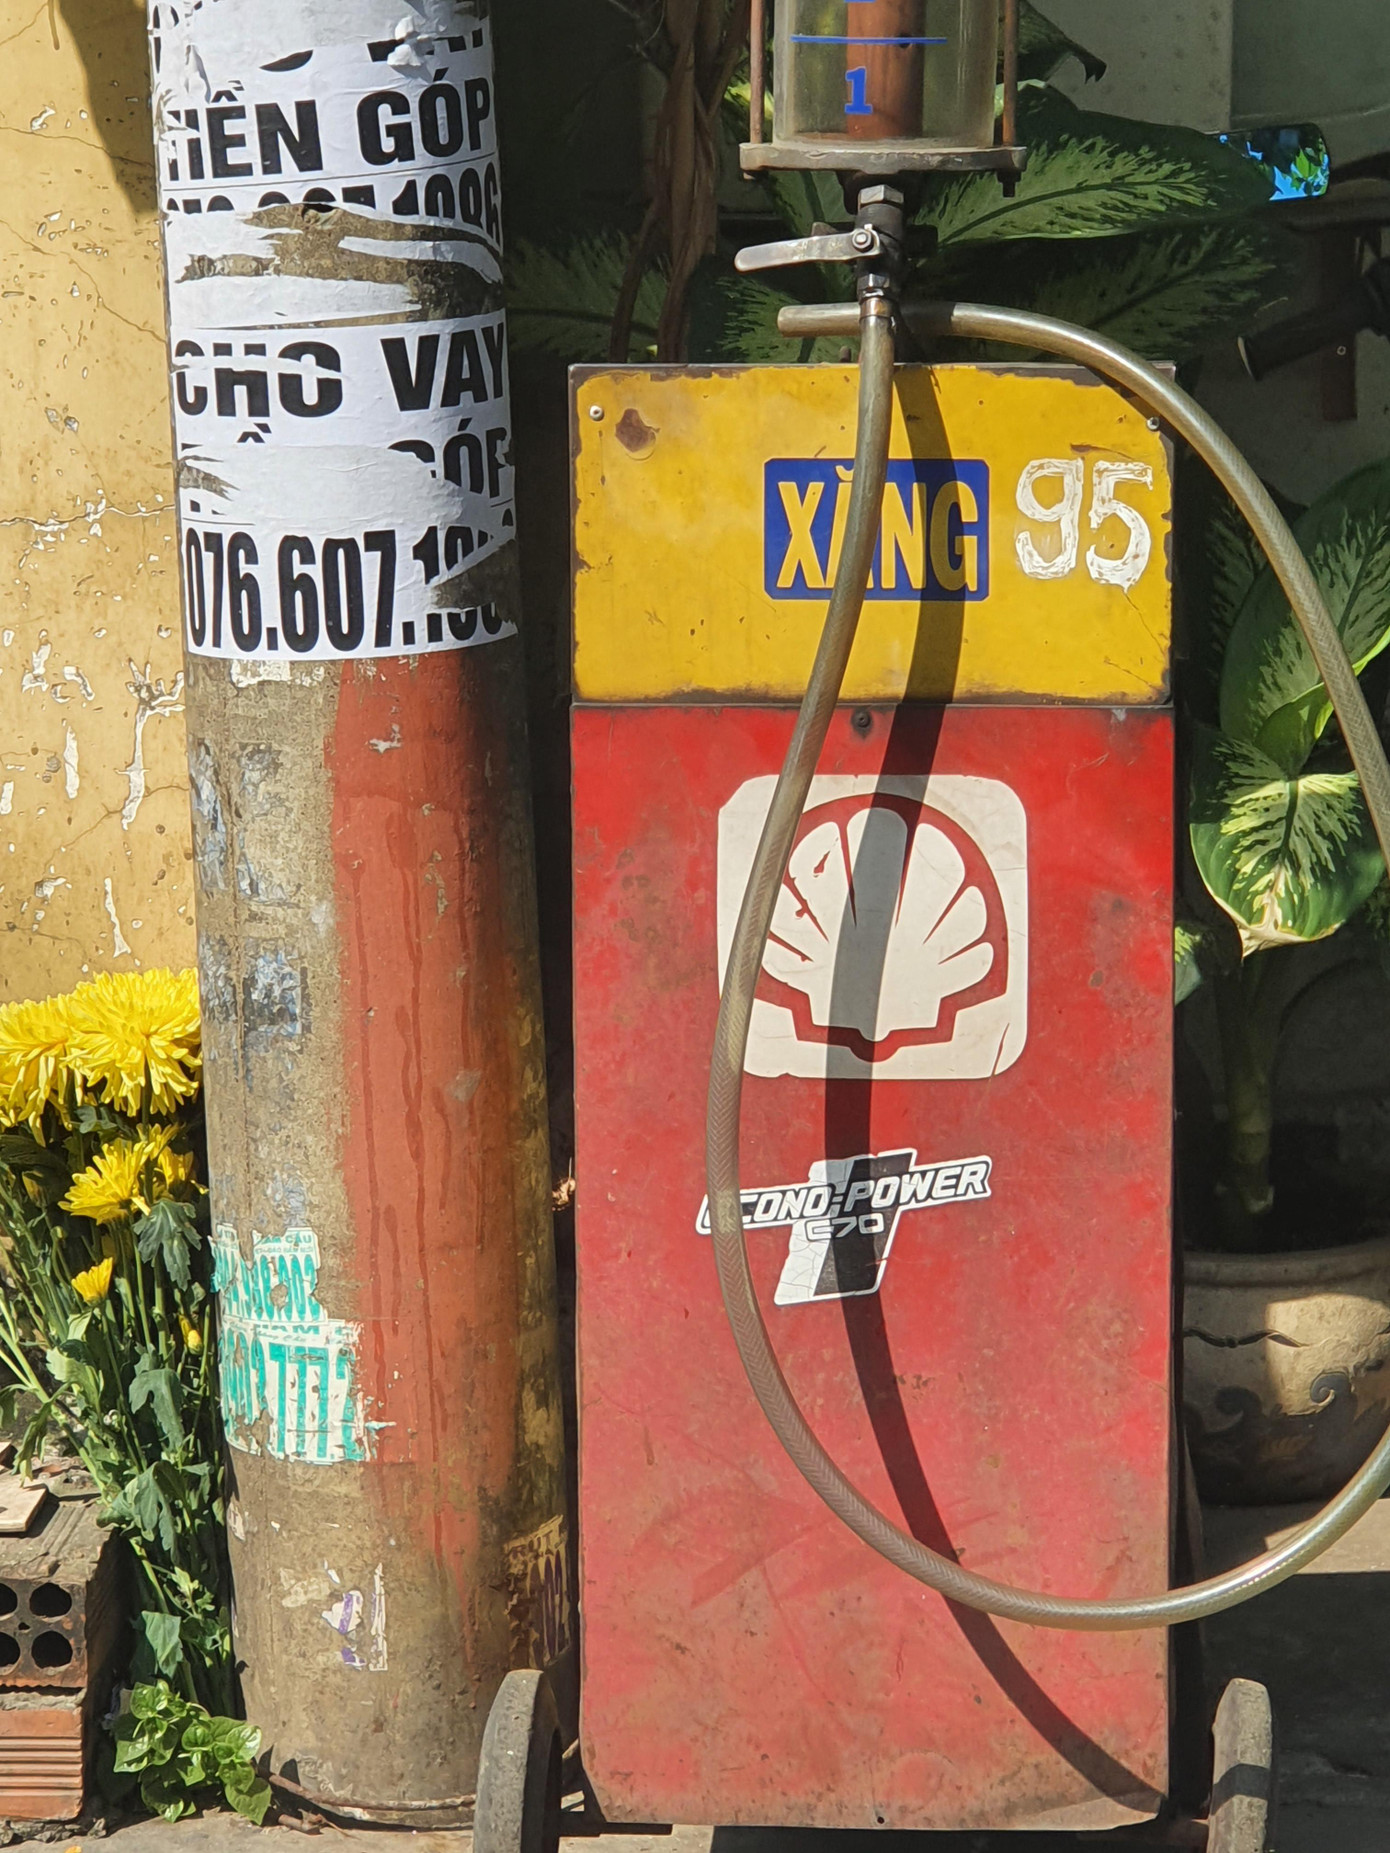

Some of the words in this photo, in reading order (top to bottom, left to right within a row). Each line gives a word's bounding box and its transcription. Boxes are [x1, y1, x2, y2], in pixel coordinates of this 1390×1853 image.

[356, 67, 491, 166] GÓP
[845, 66, 873, 115] 1
[175, 339, 344, 418] CHO
[380, 321, 504, 412] VAY
[387, 417, 508, 499] ÓP
[1014, 456, 1153, 594] 95
[703, 1163, 987, 1227] CONO-POWER
